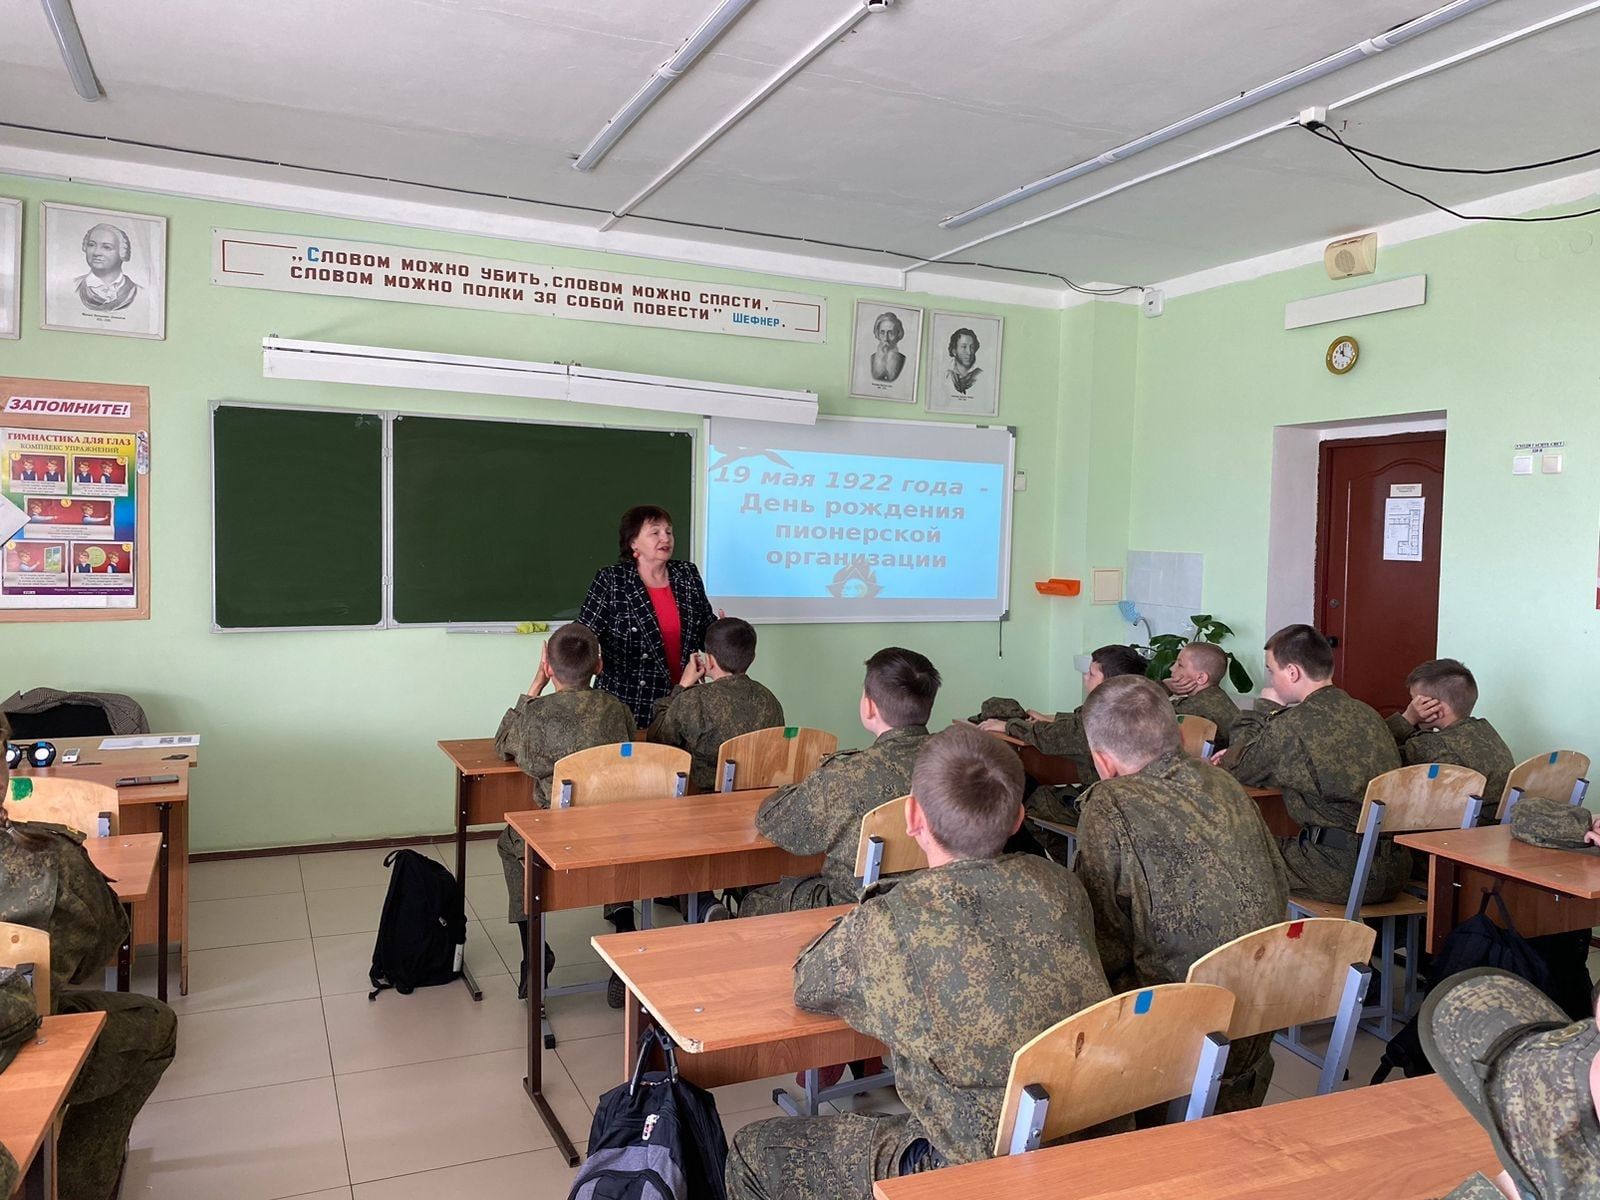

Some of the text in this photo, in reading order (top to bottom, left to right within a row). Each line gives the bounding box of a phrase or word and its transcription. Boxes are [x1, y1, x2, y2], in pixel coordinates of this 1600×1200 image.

[290, 266, 373, 285] СЛОВОМ
[384, 274, 452, 293] МОЖНО
[462, 282, 524, 301] ПОЛКИ
[534, 291, 557, 305] ЗА
[566, 295, 624, 312] СОБОЙ
[401, 258, 470, 278] МОЖНО
[481, 268, 548, 288] УБИТЬ,
[552, 276, 623, 295] СЛОВОМ
[632, 285, 691, 302] МОЖНО
[699, 293, 769, 311] СПАСТИ,
[9, 398, 129, 416] ЗАПОМНИТЕ!
[7, 432, 131, 446] ГИМНАСТИКА ДЛЯ ГЛАЗ
[20, 443, 119, 454] КОМПЛЕКС УПРАЖНЕНИЙ
[713, 466, 750, 483] 19
[760, 471, 815, 487] мая
[825, 471, 893, 491] 1922
[901, 478, 963, 495] года
[740, 493, 965, 519] День рождения
[775, 525, 941, 545] пионерской
[766, 549, 947, 569] организации
